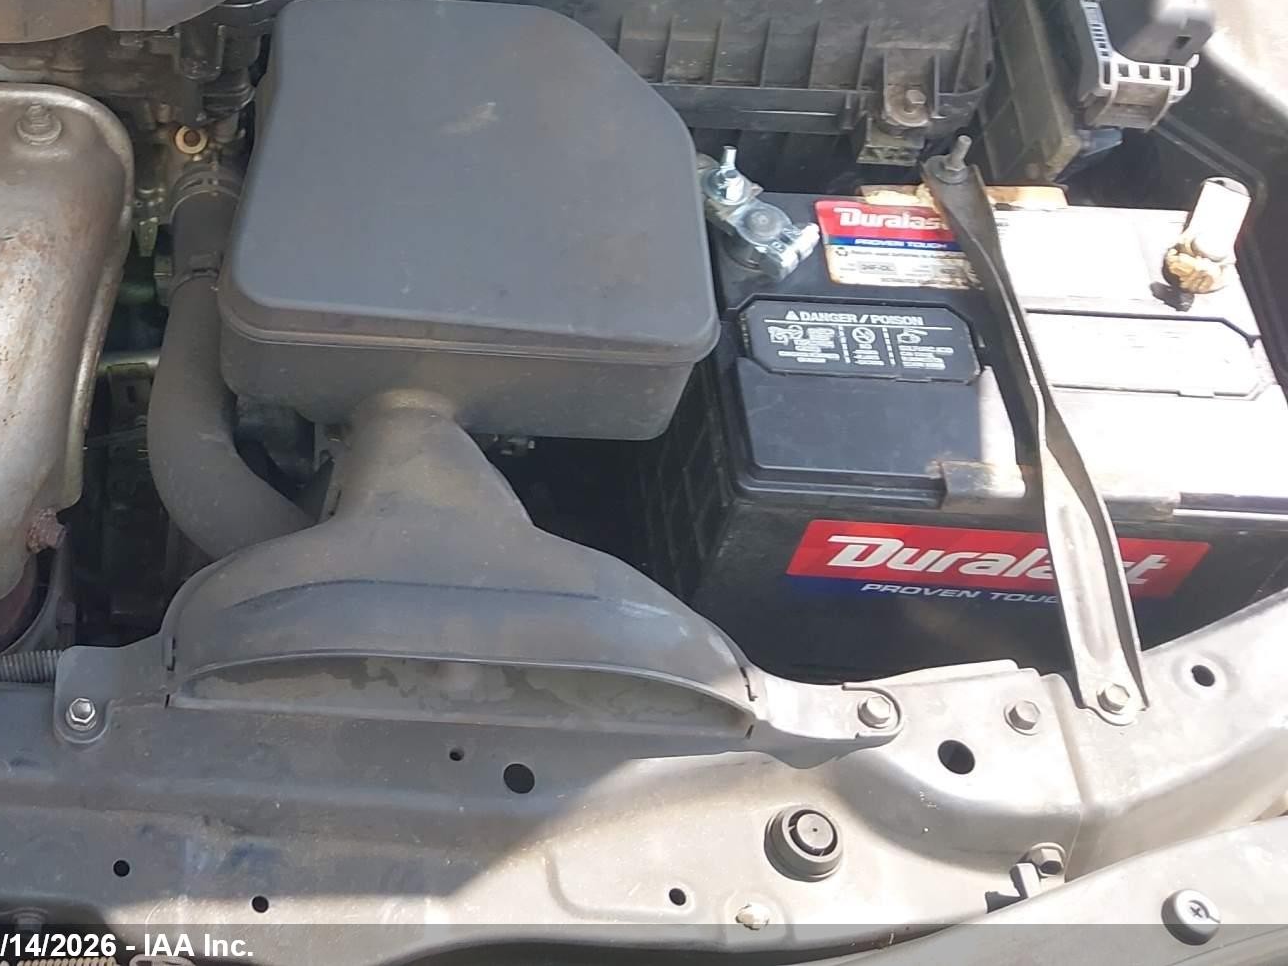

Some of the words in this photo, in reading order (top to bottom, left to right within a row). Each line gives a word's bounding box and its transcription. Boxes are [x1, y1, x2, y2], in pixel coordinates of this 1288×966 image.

[800, 311, 858, 323] DANGER
[870, 314, 924, 326] POISON
[861, 583, 980, 598] PROVEN
[990, 591, 1059, 604] TOUG
